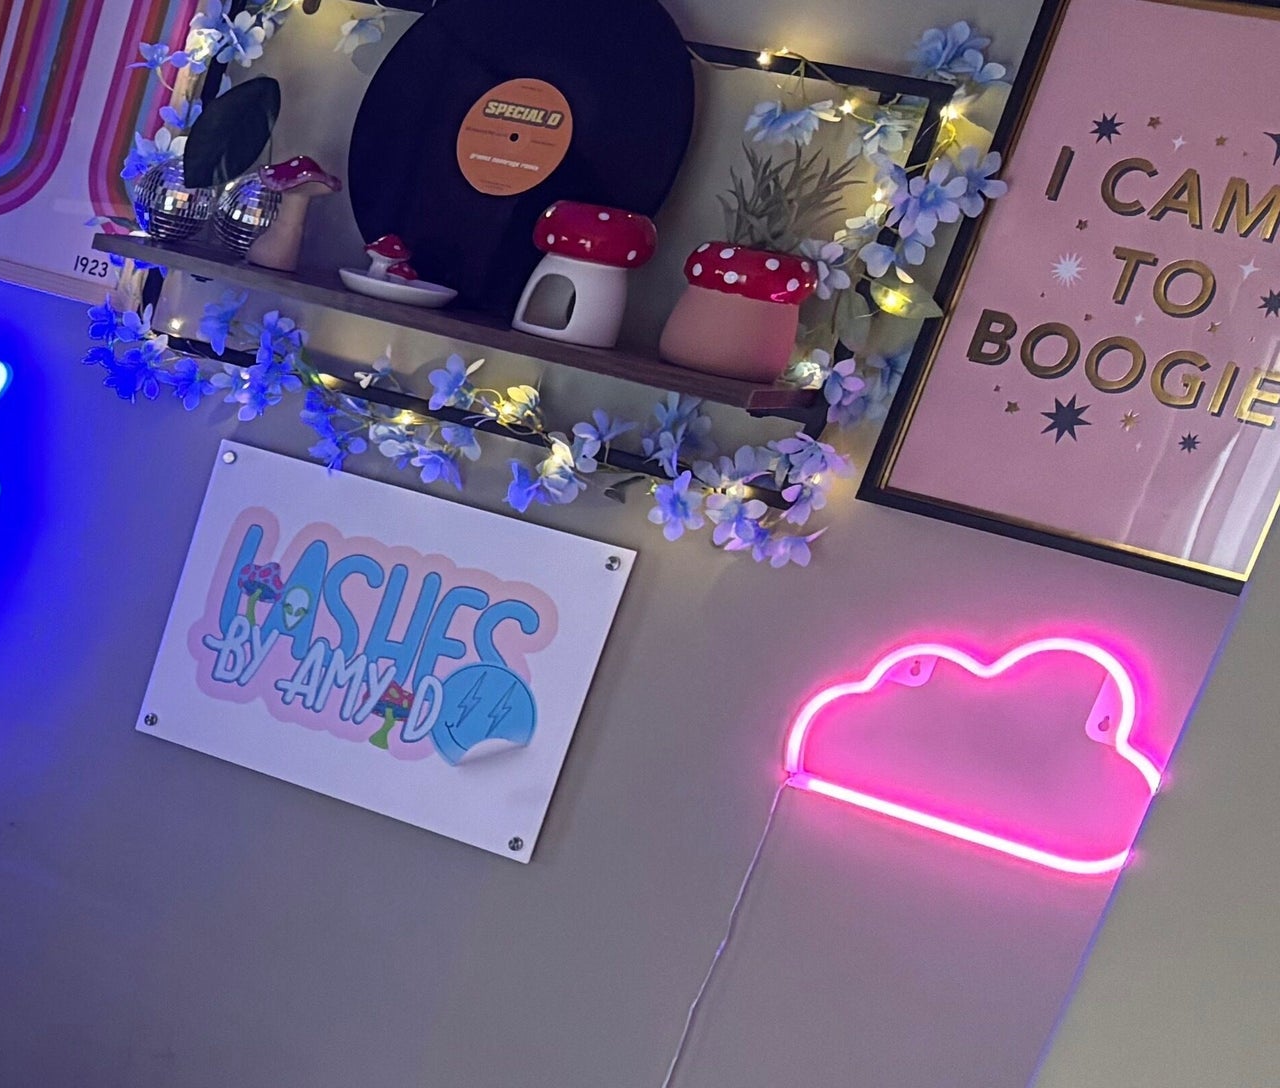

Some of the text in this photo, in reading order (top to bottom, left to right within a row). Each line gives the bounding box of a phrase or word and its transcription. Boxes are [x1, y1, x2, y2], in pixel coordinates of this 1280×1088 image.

[485, 101, 563, 127] SPECIAL D
[1045, 145, 1075, 201] I
[73, 255, 109, 278] 1923
[1113, 246, 1217, 318] TO
[966, 308, 1280, 428] BOOGIE
[219, 524, 540, 692] LASHES
[203, 614, 444, 743] BY AMY D
